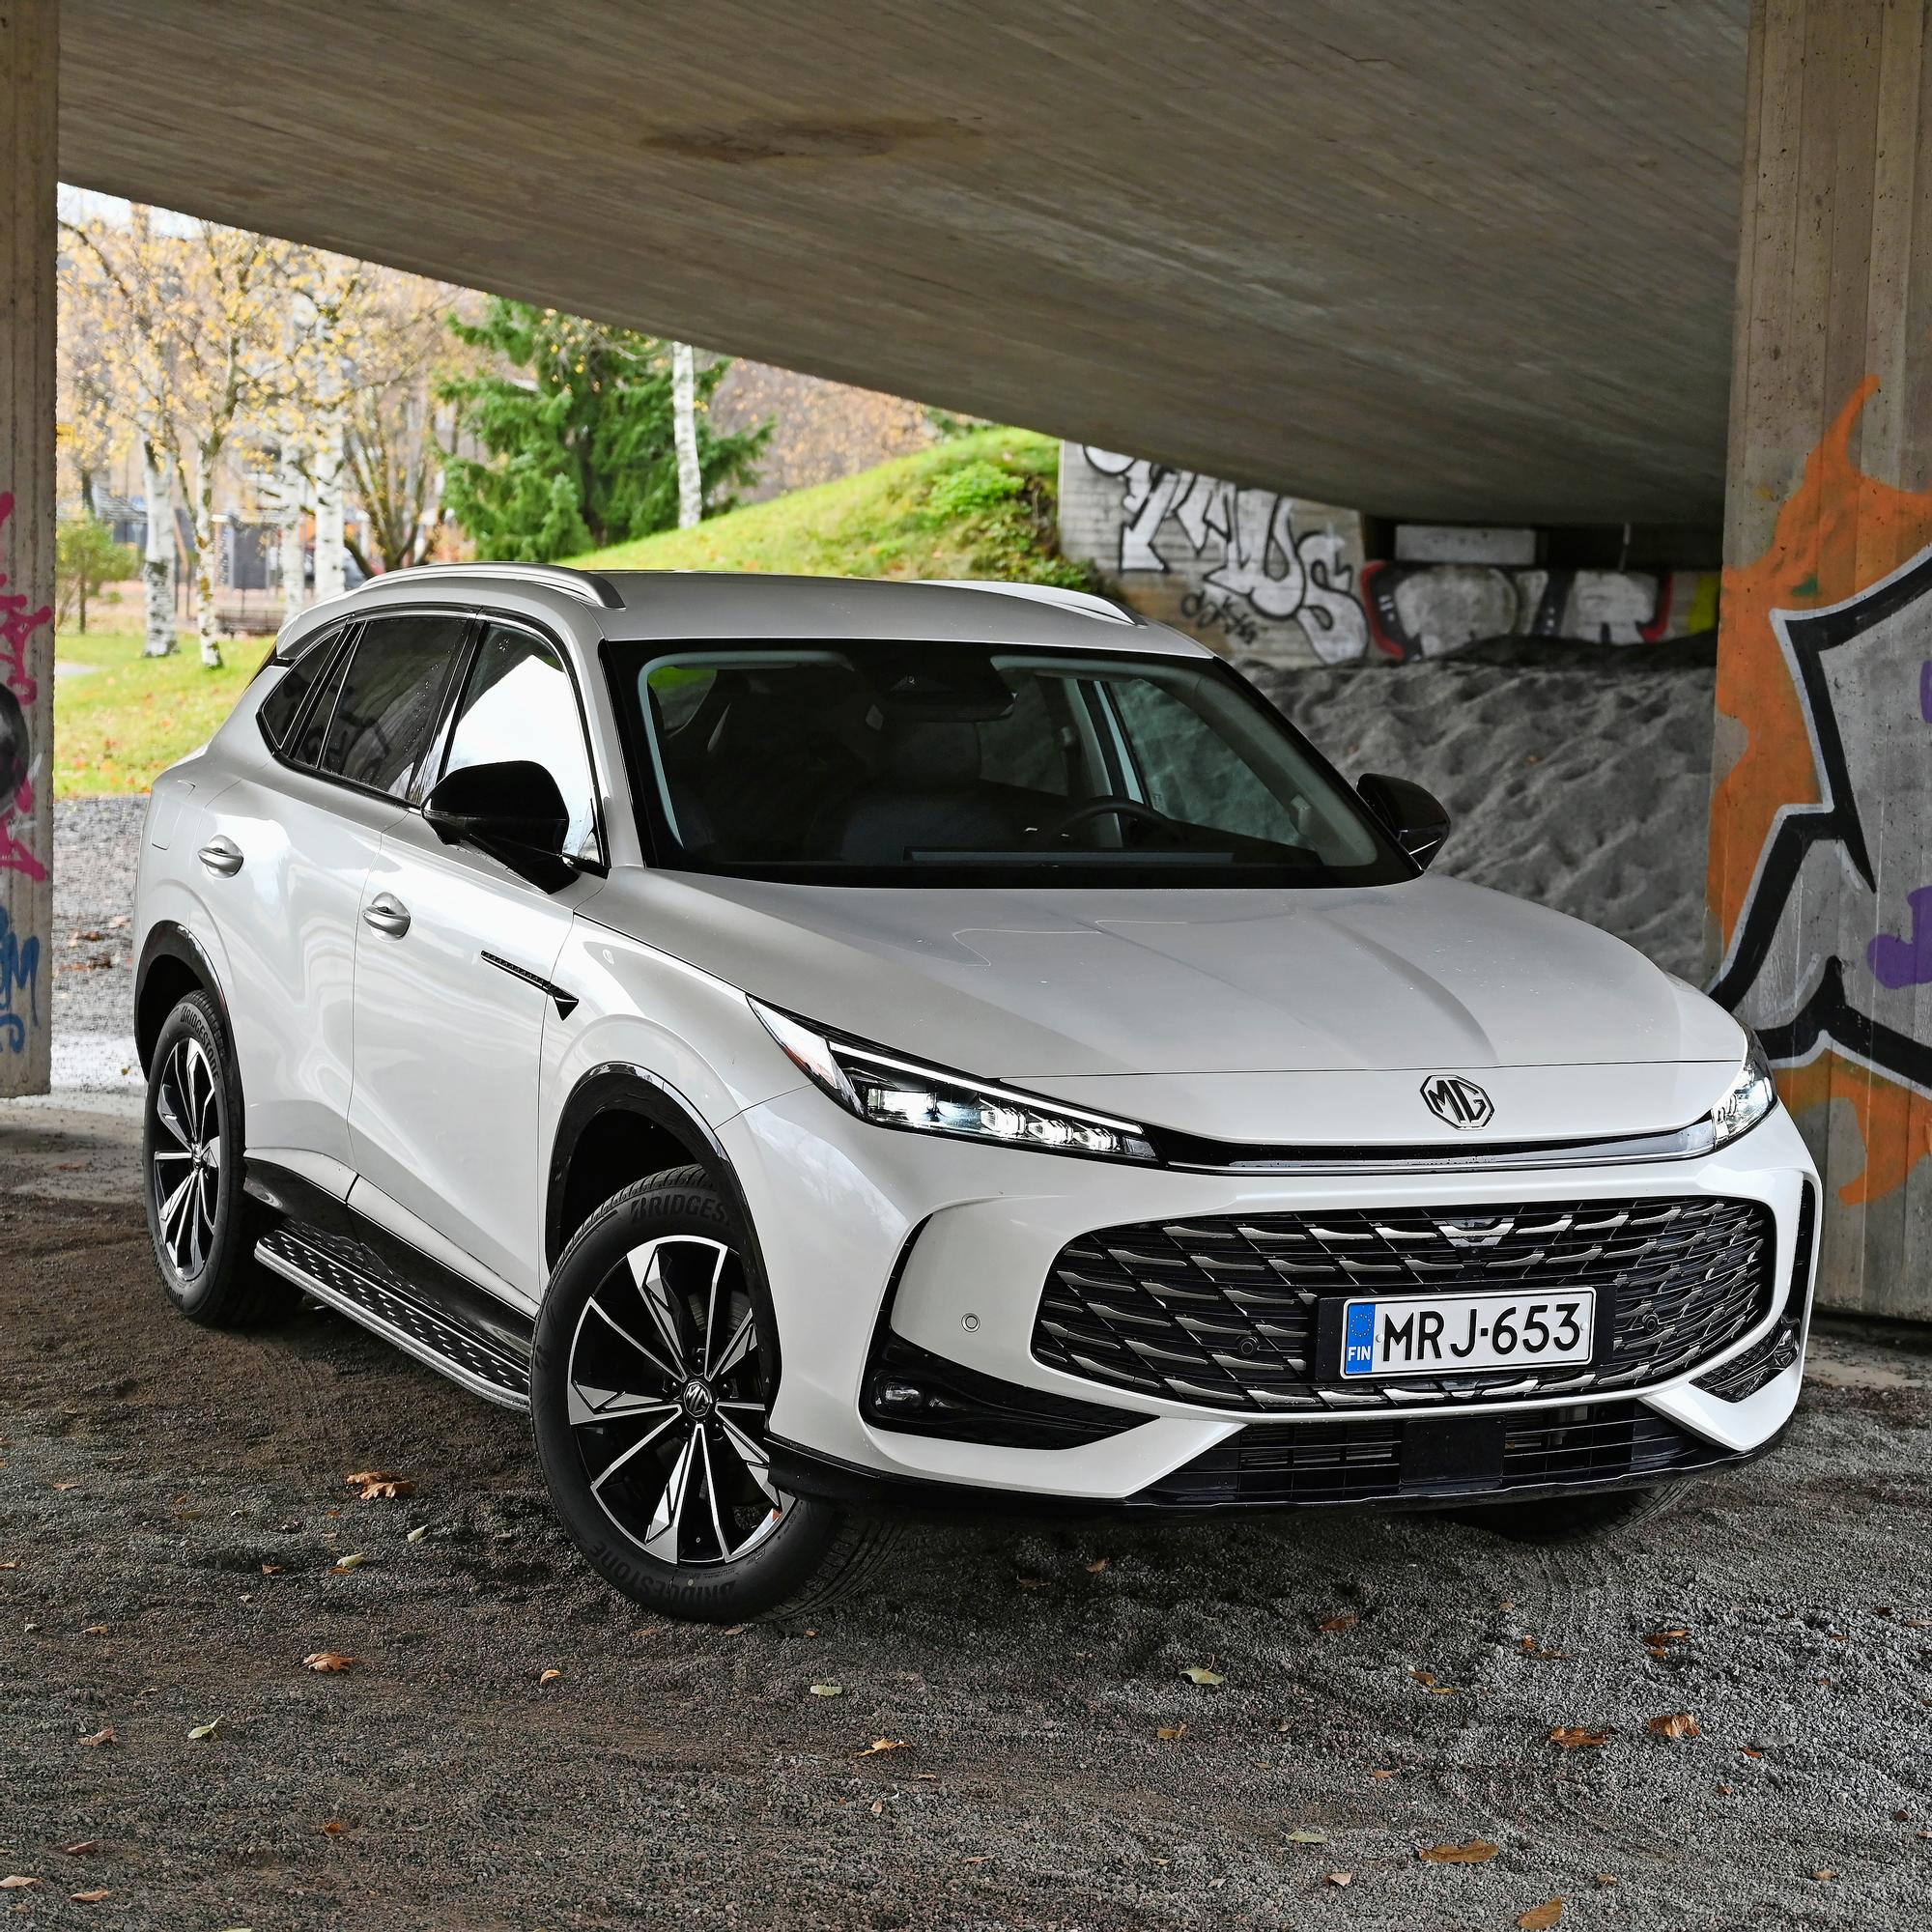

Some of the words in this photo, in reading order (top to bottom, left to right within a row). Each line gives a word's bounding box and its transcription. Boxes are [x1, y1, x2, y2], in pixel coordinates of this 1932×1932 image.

[180, 1006, 220, 1081] BRIDGESTONE
[1426, 1078, 1489, 1125] MG
[630, 1193, 729, 1225] BRIDGES
[1348, 1345, 1371, 1362] FIN
[1382, 1302, 1581, 1362] MRJ-653
[684, 1383, 711, 1415] MG
